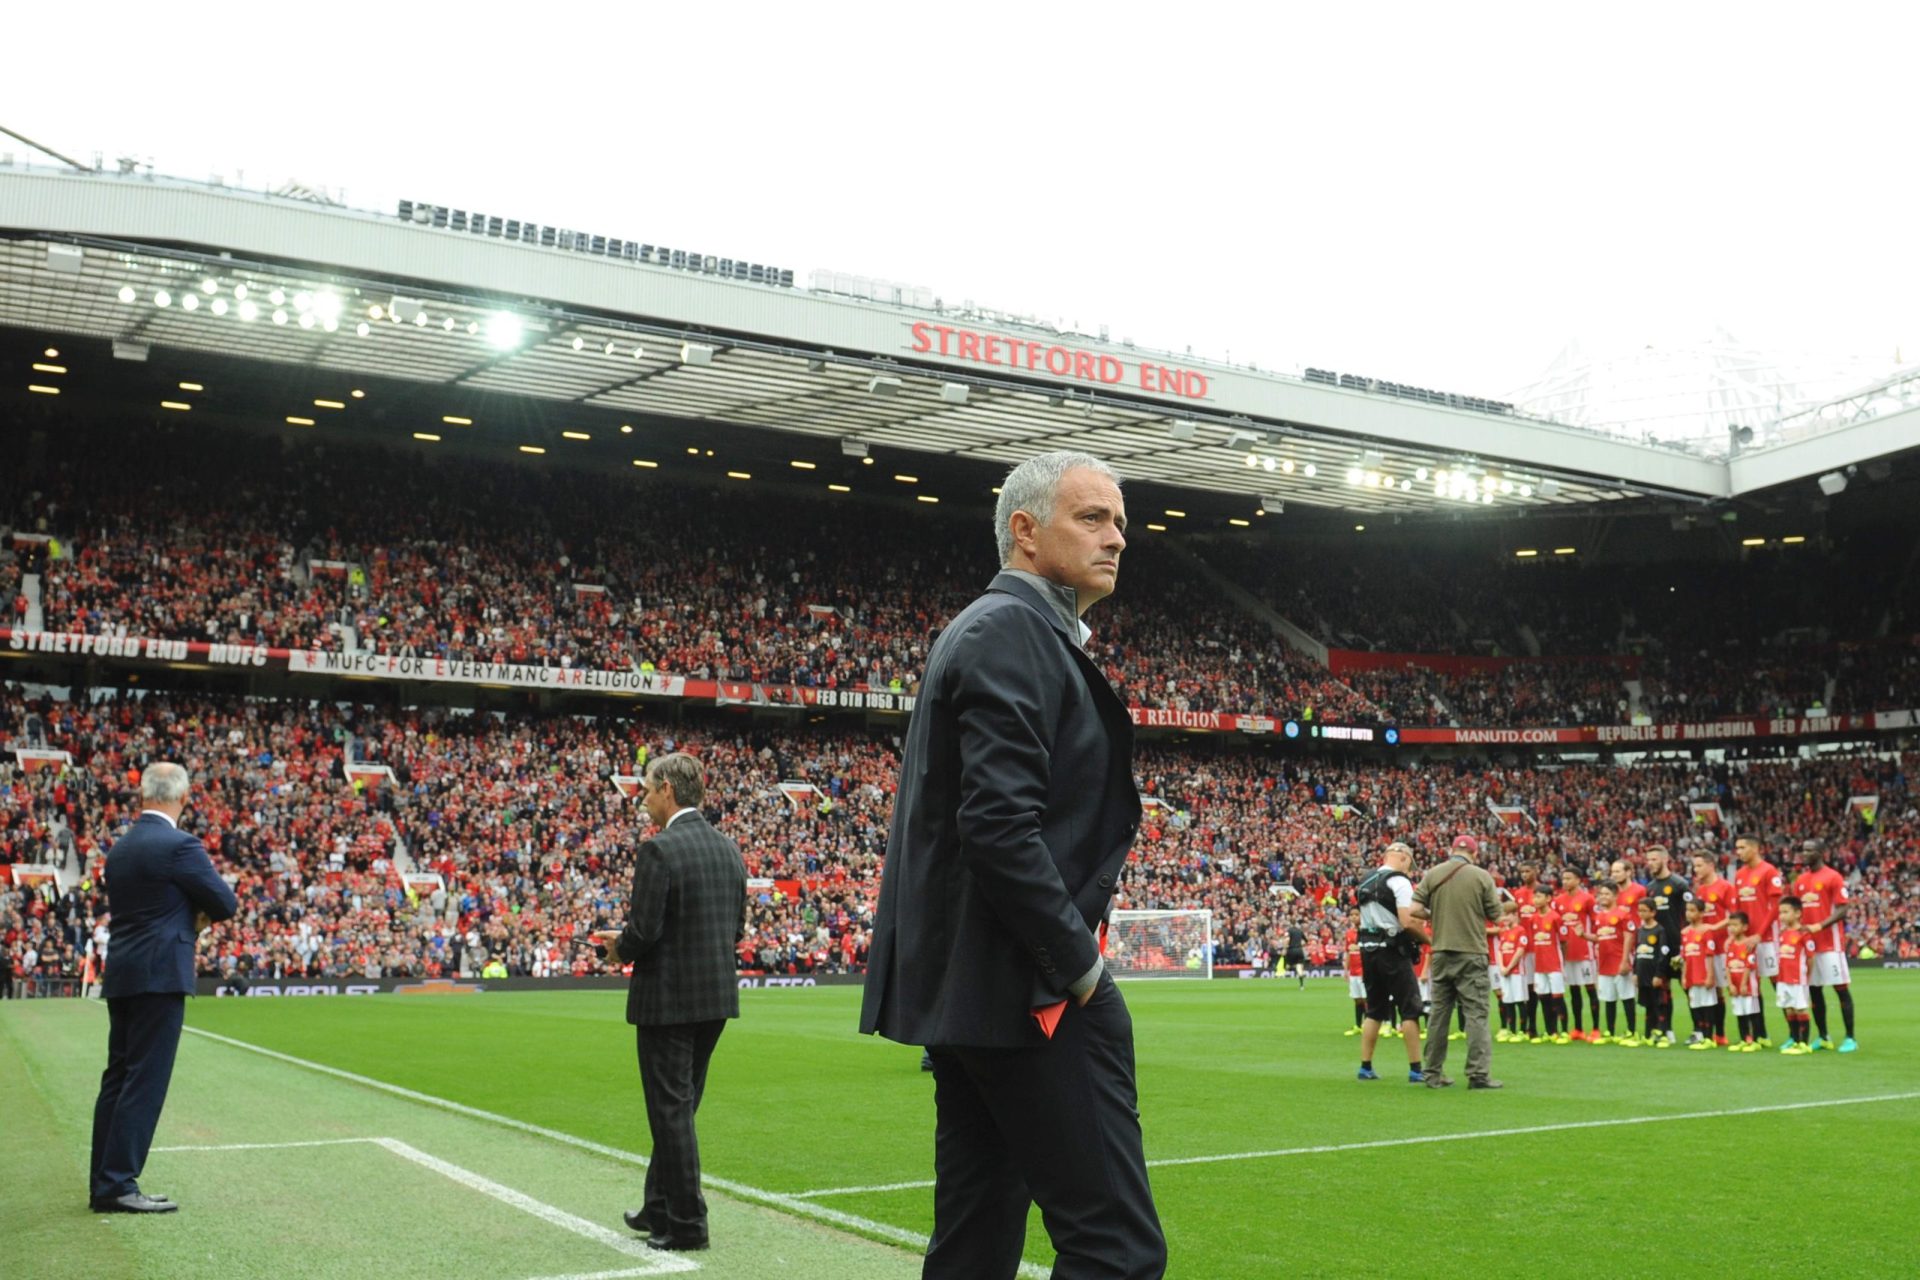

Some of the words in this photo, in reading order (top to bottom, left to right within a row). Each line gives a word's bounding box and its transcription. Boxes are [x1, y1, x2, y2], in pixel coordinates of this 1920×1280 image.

[911, 321, 1124, 384] STRETFORD
[1139, 362, 1208, 399] END
[9, 630, 140, 657] STRETFORD
[145, 638, 189, 661] END
[208, 643, 268, 667] MUFC
[572, 668, 655, 690] RELIGION
[816, 689, 837, 706] FEB
[840, 691, 863, 708] 6TH
[866, 693, 893, 709] 1958
[1147, 709, 1220, 728] RELIGION
[1455, 728, 1558, 743] MANUTD.COM
[1662, 724, 1678, 739] OF
[1764, 956, 1776, 969] 12
[1832, 964, 1840, 977] 3
